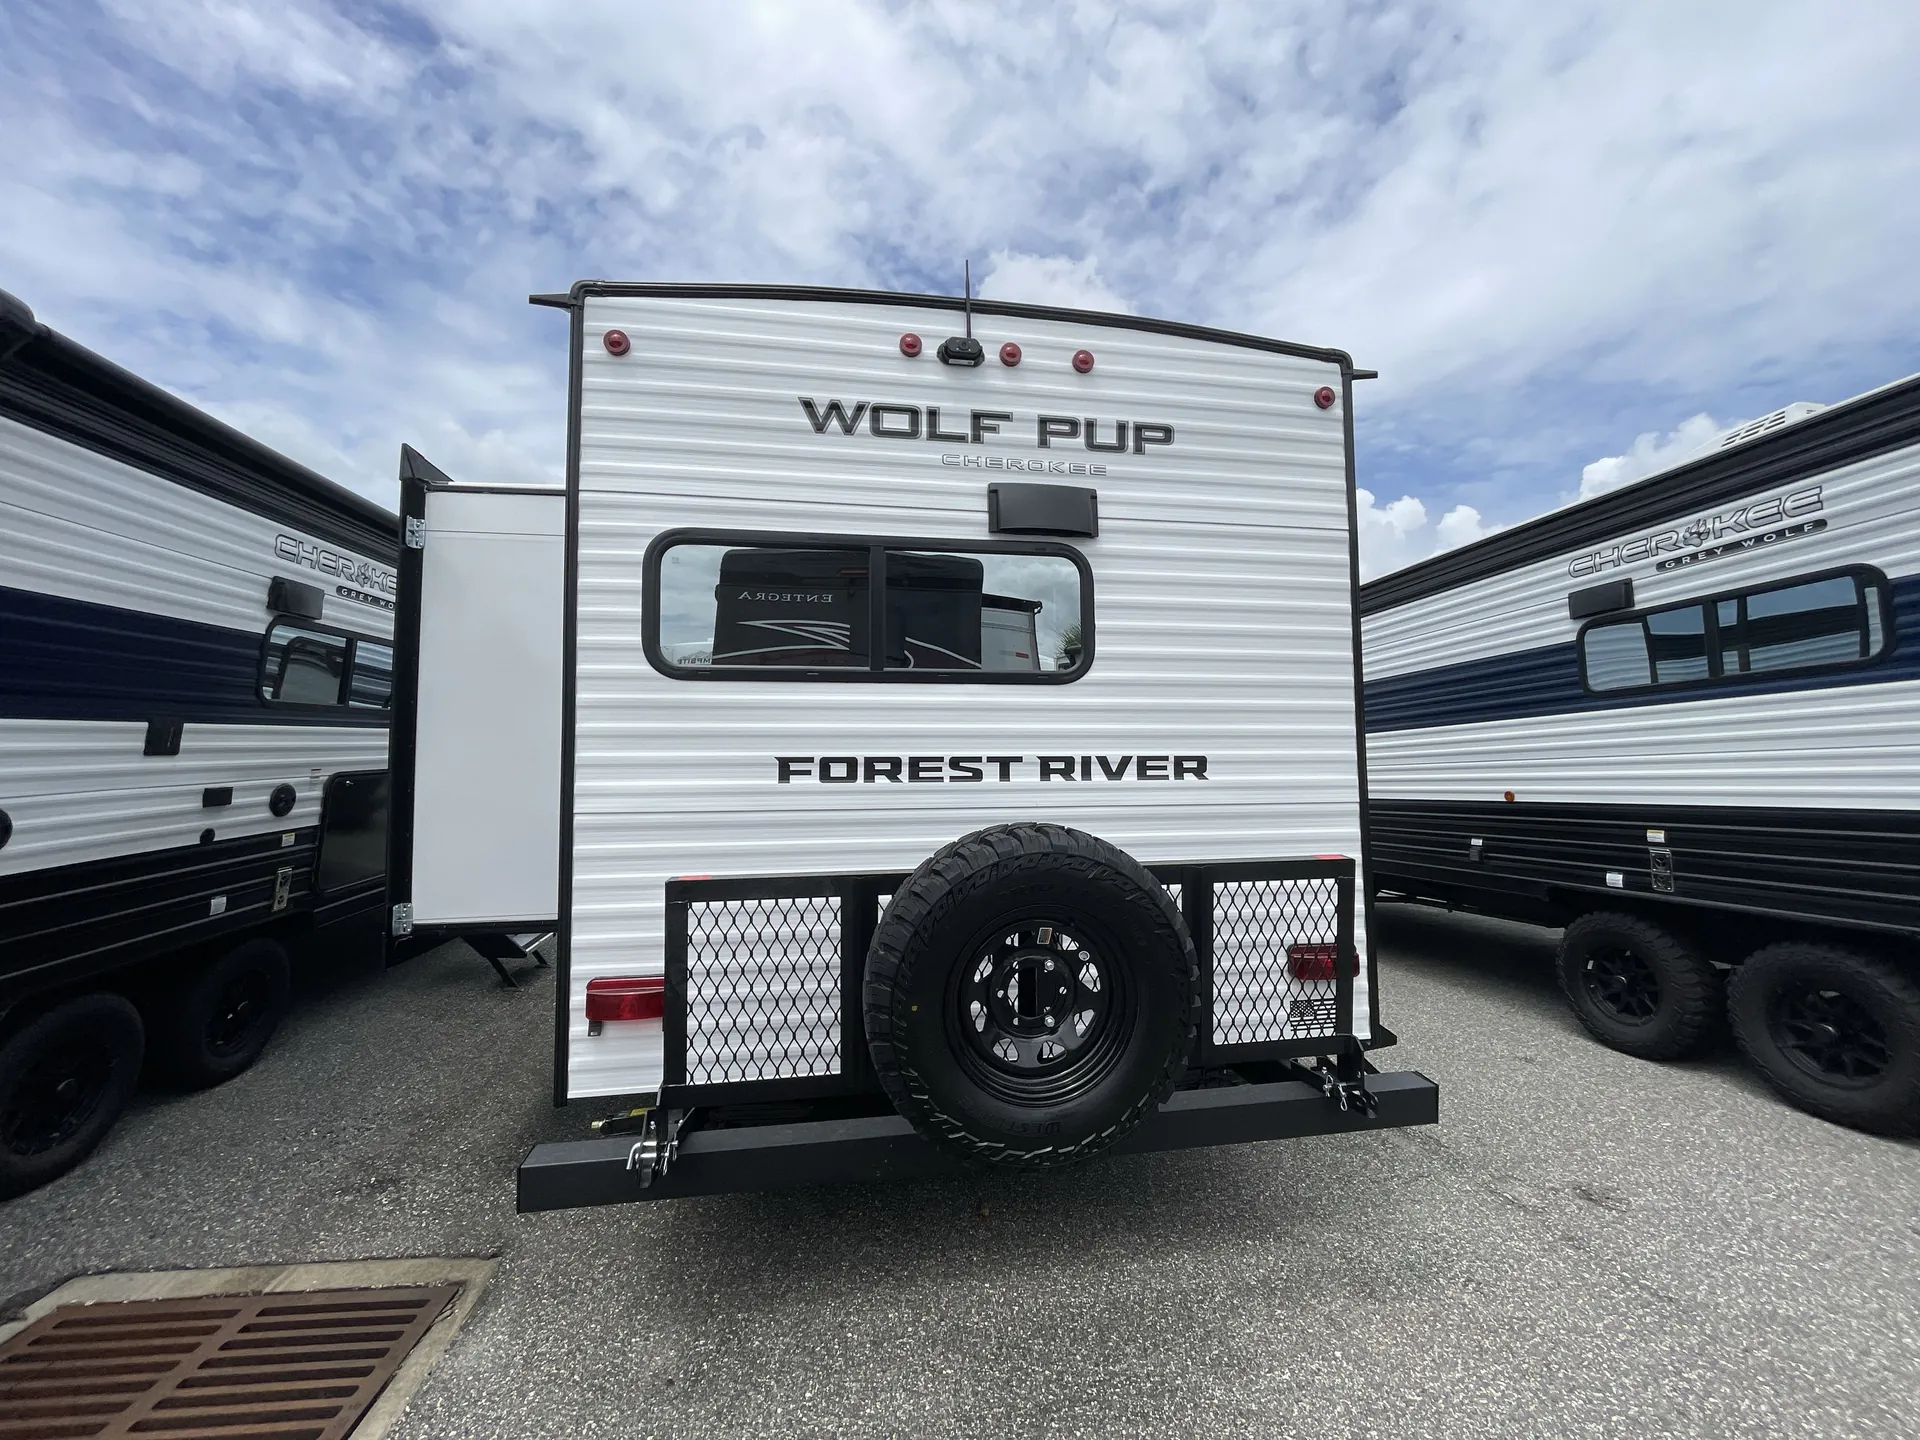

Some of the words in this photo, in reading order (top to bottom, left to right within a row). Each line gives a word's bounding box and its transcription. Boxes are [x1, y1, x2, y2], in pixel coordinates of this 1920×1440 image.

[797, 396, 1014, 444] WOLF
[1037, 413, 1176, 455] PUP
[941, 453, 1108, 477] CHEROKEE
[1664, 546, 1725, 569] GREY
[1741, 522, 1815, 549] WOLF
[341, 587, 373, 603] GREY
[773, 756, 1024, 784] FOREST
[1035, 755, 1210, 782] RIVER
